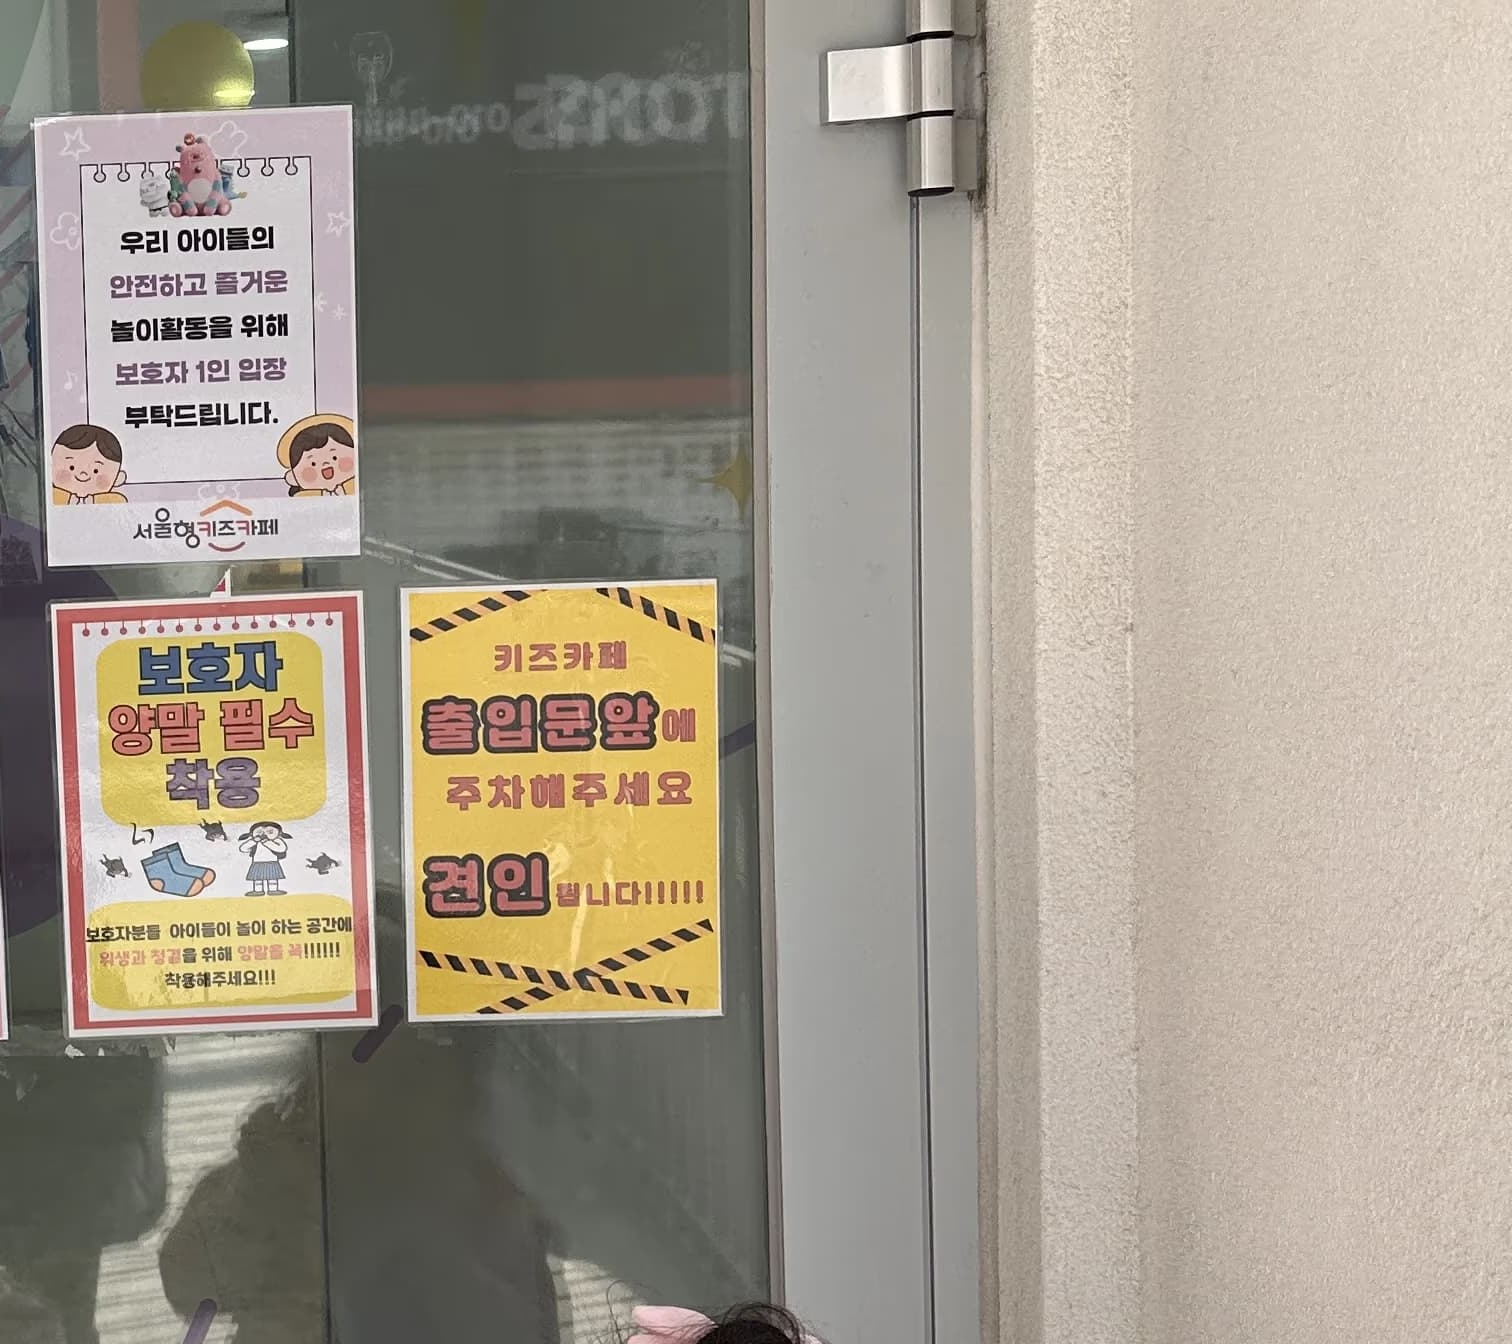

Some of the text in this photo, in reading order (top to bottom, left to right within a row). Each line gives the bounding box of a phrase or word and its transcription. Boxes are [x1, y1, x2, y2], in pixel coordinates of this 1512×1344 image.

[120, 226, 274, 254] 우리 아이들의
[109, 270, 288, 299] 안전하고 즐거운
[110, 314, 288, 343] 놀이활동을 위해
[115, 357, 286, 387] 보호자 1인 입장
[124, 402, 279, 429] 부탁드립니다.
[137, 640, 284, 696] 보호자
[494, 640, 627, 672] 키즈카페
[108, 697, 314, 756] 양말 필수
[165, 757, 261, 810] 착용
[447, 771, 692, 811] 주차해주세요
[86, 916, 352, 943] 보호자분들 아이들이 놀이 하는 공간에
[202, 947, 232, 962] 위해
[238, 944, 283, 961] 양말을
